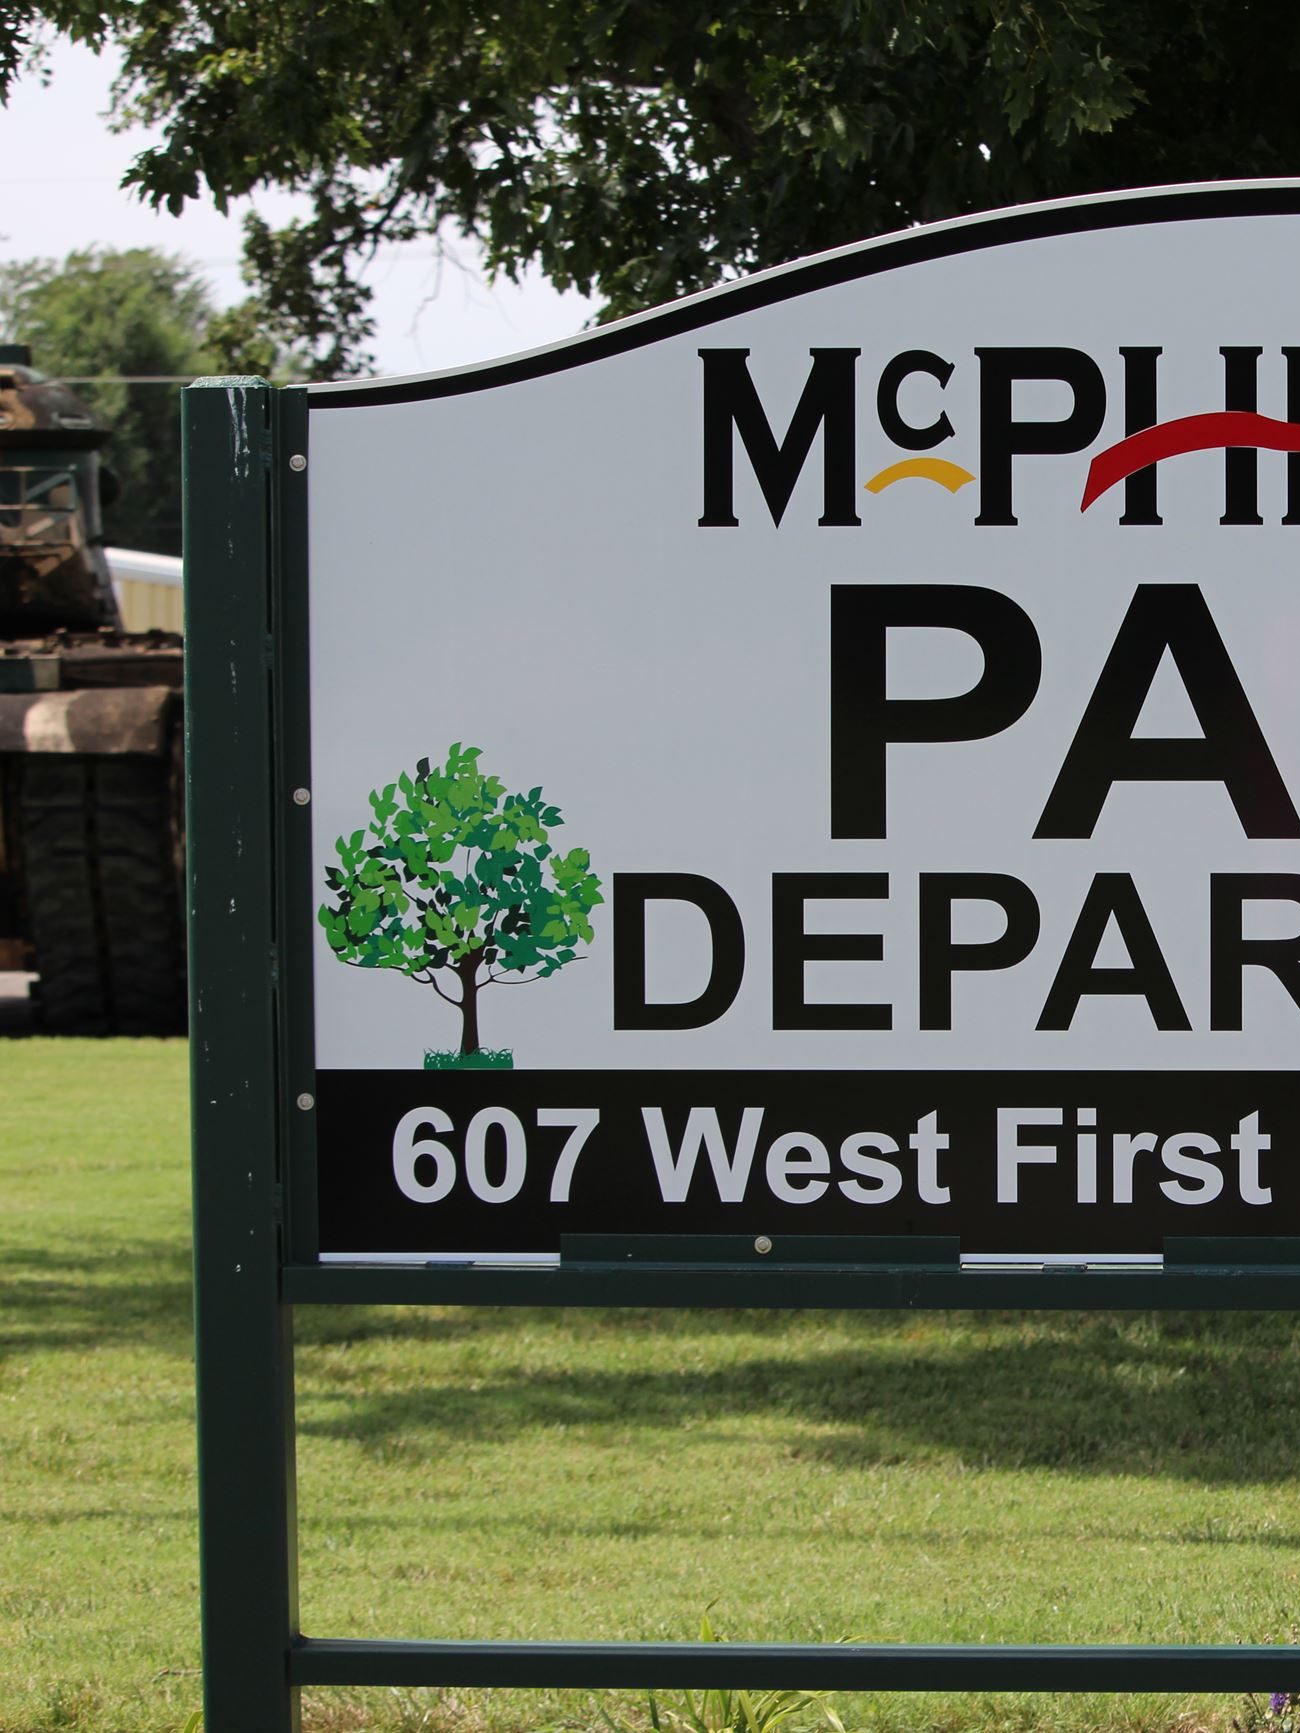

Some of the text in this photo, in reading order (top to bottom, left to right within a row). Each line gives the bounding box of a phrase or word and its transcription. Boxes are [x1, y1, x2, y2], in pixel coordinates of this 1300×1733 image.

[392, 1106, 1273, 1205] 607 West First
